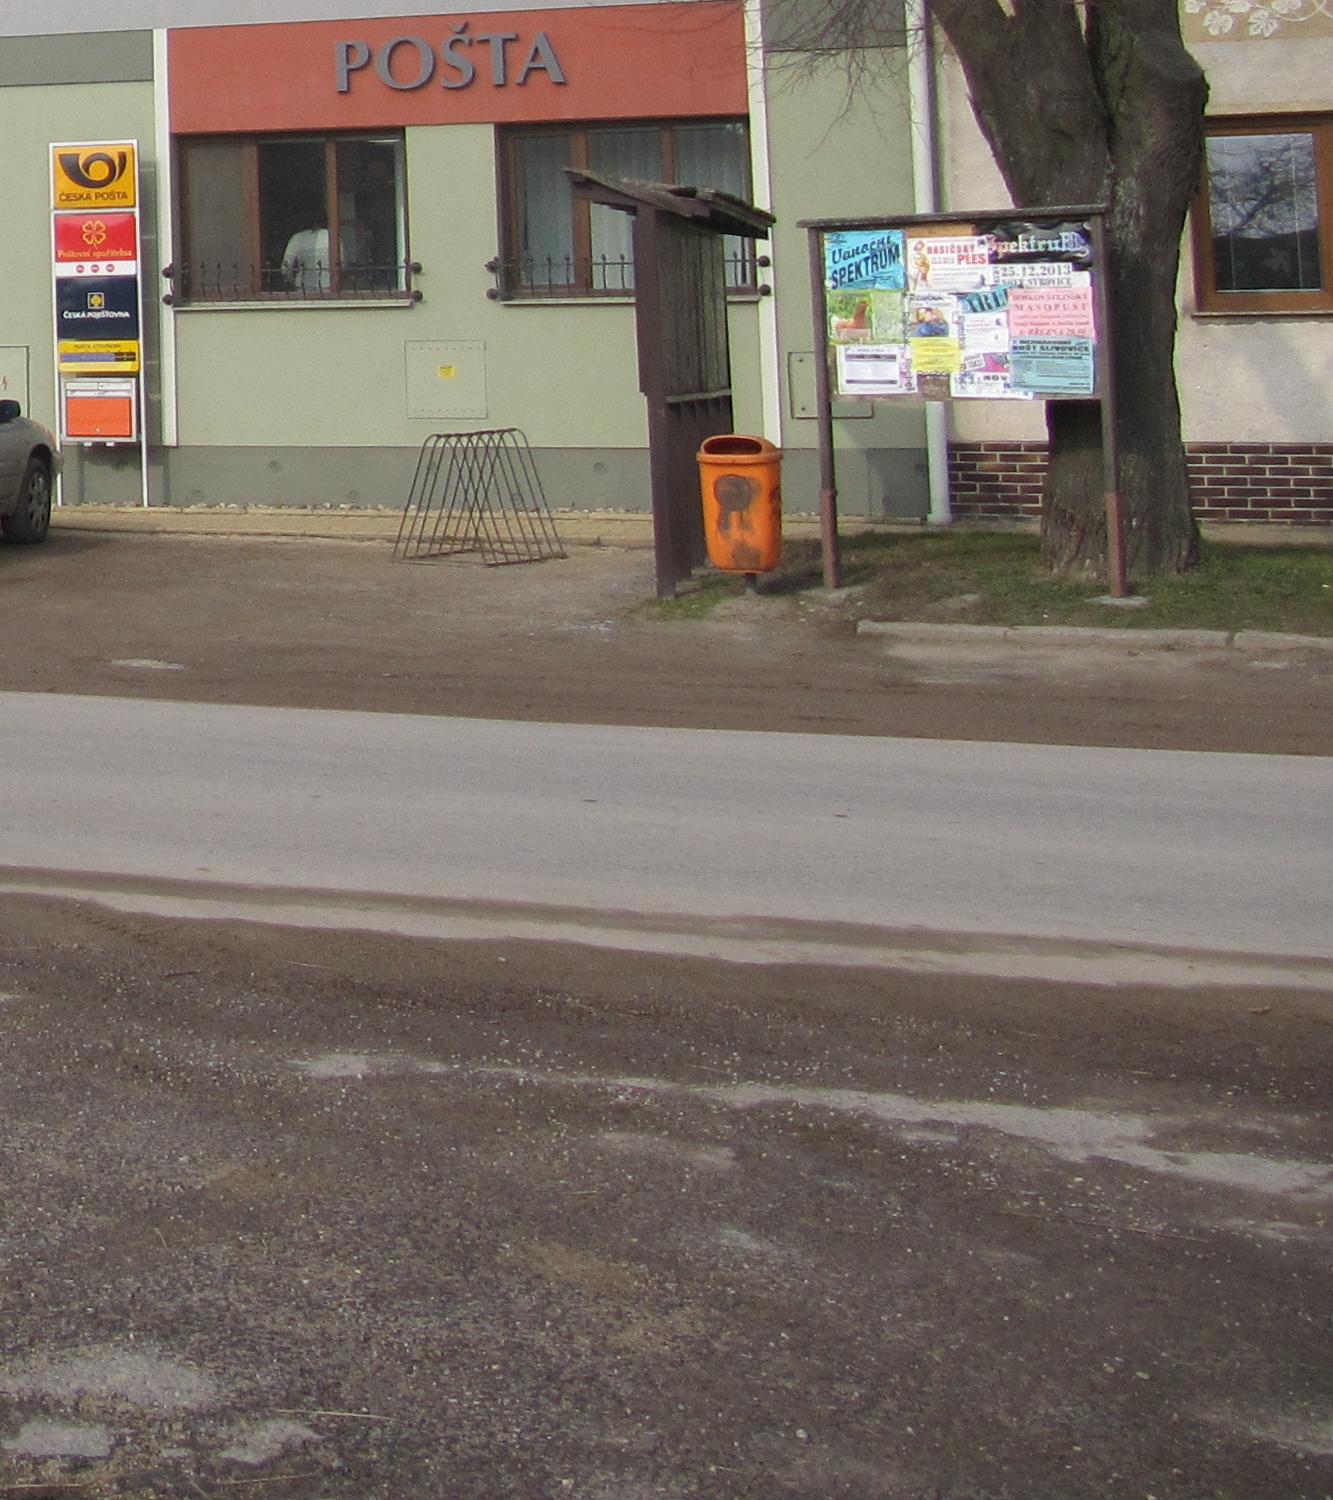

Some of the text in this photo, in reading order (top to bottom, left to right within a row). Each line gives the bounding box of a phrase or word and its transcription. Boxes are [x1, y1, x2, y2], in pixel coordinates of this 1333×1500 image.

[335, 22, 567, 93] POŠTA
[59, 190, 128, 201] ČESKÁ POŠTA
[957, 253, 986, 265] PLES
[831, 244, 900, 290] SPEKTRUM
[1001, 264, 1071, 277] 25.12.2013
[1014, 303, 1088, 311] MASOPUST
